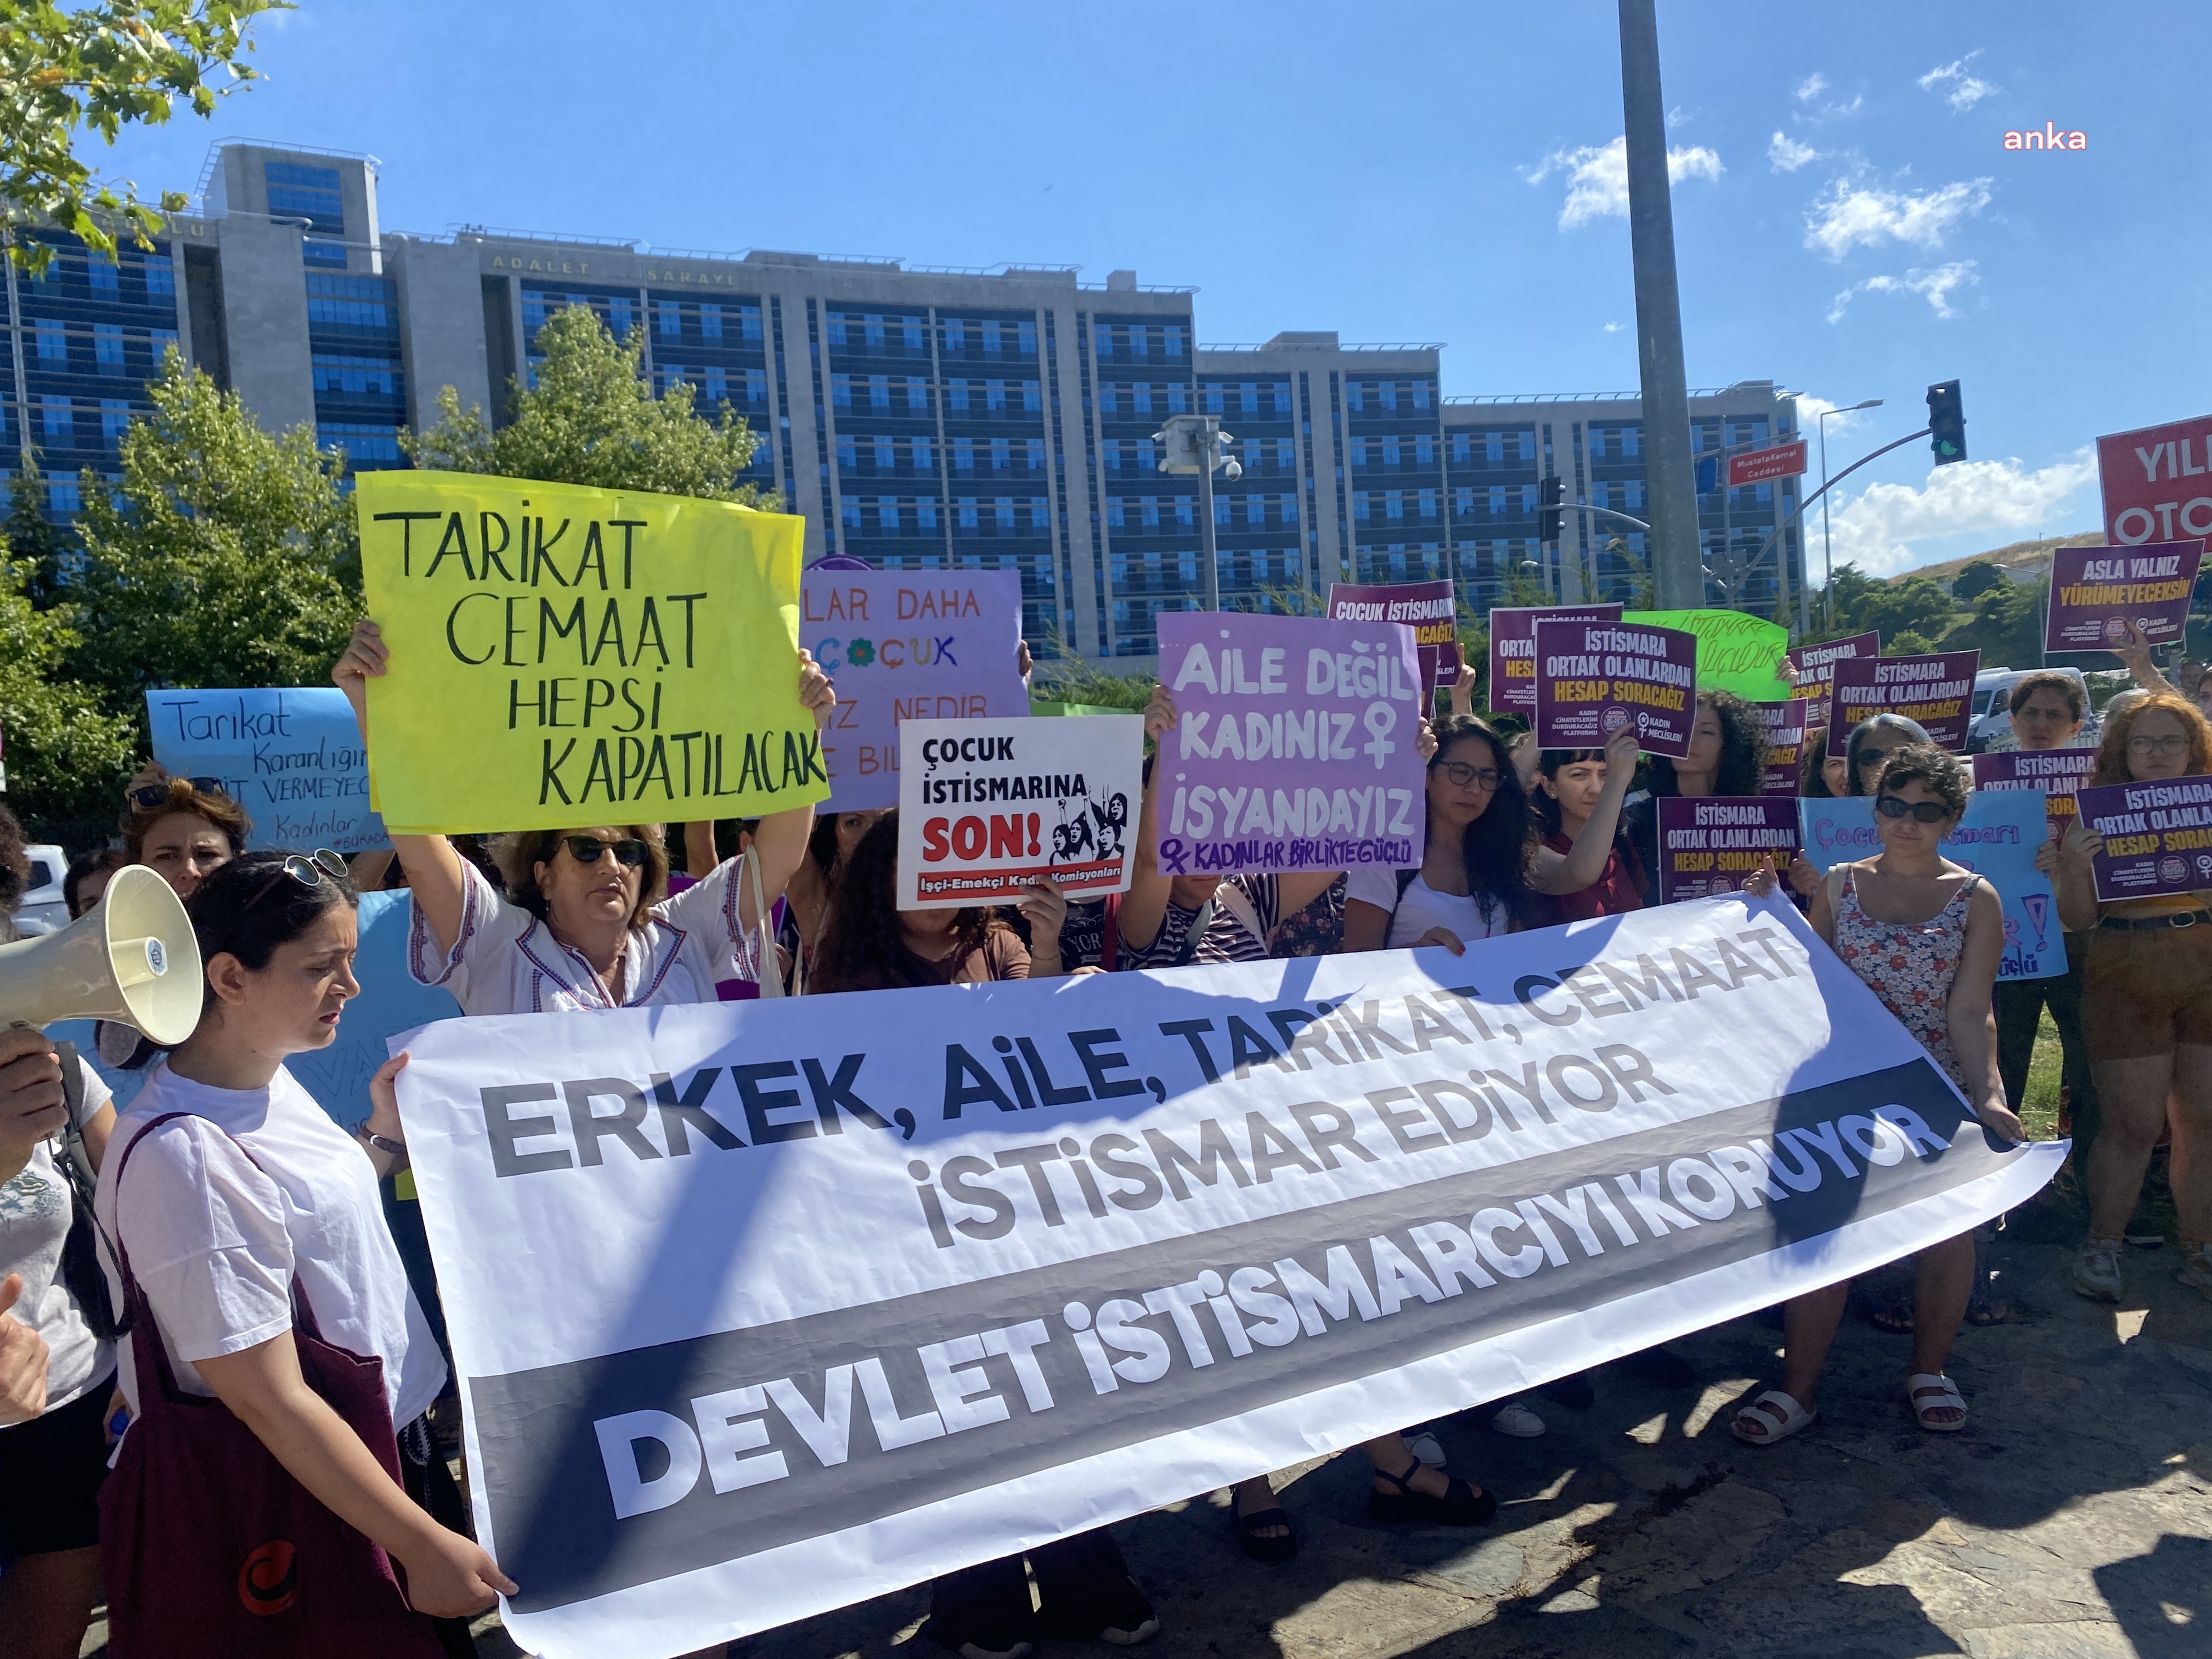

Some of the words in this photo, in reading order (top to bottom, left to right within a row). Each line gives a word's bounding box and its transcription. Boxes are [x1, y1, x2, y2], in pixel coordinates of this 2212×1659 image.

[494, 256, 589, 275] ADALET
[648, 269, 733, 286] SARAYI
[1737, 456, 1770, 469] Mustafa
[1771, 449, 1796, 460] Kemal
[1748, 465, 1785, 478] Caddesi
[374, 499, 648, 590] TARİKAT
[2083, 558, 2125, 580] ASLA
[2130, 555, 2181, 578] YALNIZ
[896, 589, 981, 620] DAHA
[2060, 577, 2191, 607] YÜRÜMEYECEKSİN
[445, 591, 708, 669] CEMAAT
[1585, 627, 1667, 657] İSTİSMARA
[1173, 629, 1288, 695] AİLE
[1306, 639, 1414, 700] DEĞİL
[1802, 643, 1857, 668] İSTİSMARA
[1547, 655, 1600, 677] ORTAK
[1605, 655, 1691, 687] OLANLARDAN
[1875, 662, 1945, 683] İSTİSMARA
[509, 665, 663, 732] HEPSİ
[1555, 681, 1609, 703] HESAP
[1613, 681, 1686, 712] SORACAĞIZ
[1841, 686, 1887, 704] ORTAK
[1890, 679, 1971, 703] OLANLARDAN
[162, 692, 291, 742] Tarikat
[1650, 716, 1671, 729] KADIN
[1180, 710, 1357, 761] KADINIZ
[1649, 728, 1683, 743] MECLİSLERİ
[539, 729, 826, 805] KAPATILACAK
[923, 736, 1014, 771] ÇOCUK
[2015, 754, 2096, 777] İSTİSMARA
[923, 771, 1087, 804] İSTİSMARINA
[1170, 772, 1415, 839] İSYANDAYIZ
[1696, 802, 1767, 826] İSTİSMARA
[923, 812, 1041, 862] SON!
[1668, 829, 1708, 849] ORTAK
[1711, 828, 1796, 848] OLANLARDAN
[2093, 812, 2149, 837] ORTAK
[1194, 839, 1285, 870] KADINLAR
[2106, 833, 2160, 857] HESAP
[1674, 852, 1715, 872] HESAP
[921, 877, 1004, 893] İşçi-Emekçi
[1051, 866, 1121, 883] Komisyonları
[479, 1053, 916, 1179] ERKEK,
[1513, 927, 1798, 1027] CEMAAT
[592, 1319, 1056, 1520] DEVLET
[1615, 1103, 1953, 1237] KORUYOR
